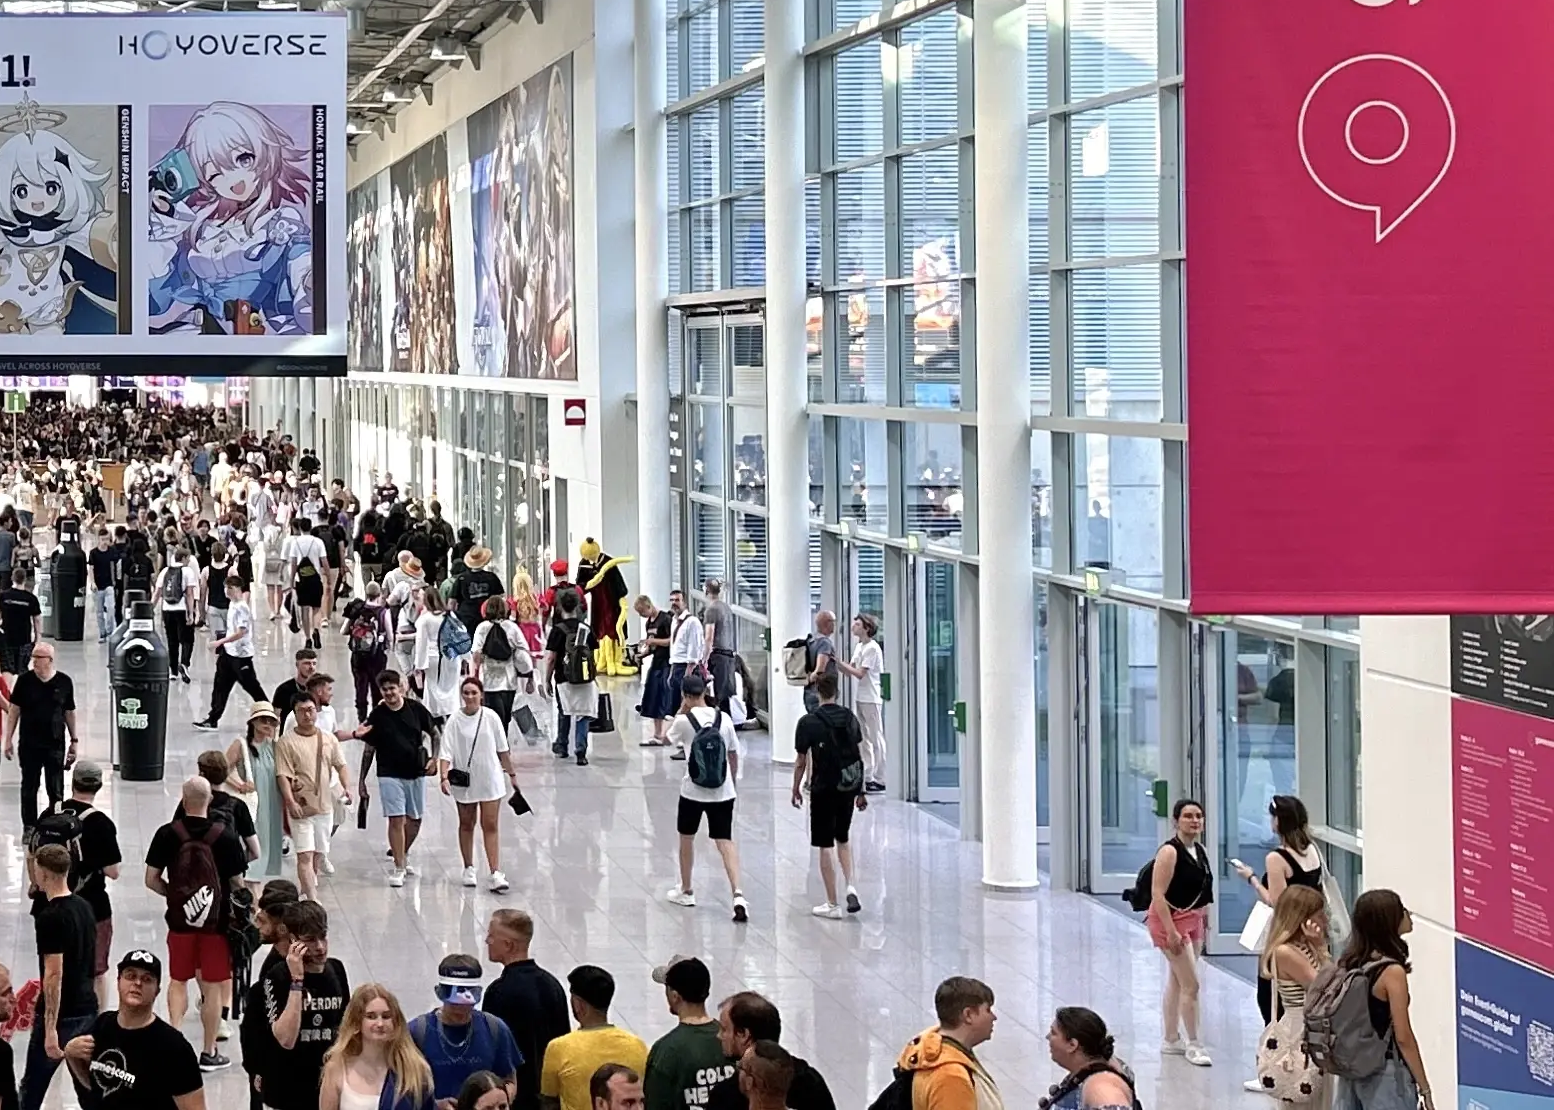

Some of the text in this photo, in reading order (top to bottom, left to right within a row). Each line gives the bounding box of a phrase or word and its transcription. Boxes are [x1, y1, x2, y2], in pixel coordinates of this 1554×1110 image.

[118, 29, 328, 61] HOYOVERSE
[121, 108, 130, 194] GENSHIN IMPACT
[315, 152, 325, 179] STAR
[315, 181, 324, 205] RAIL
[18, 362, 51, 371] ACROSS
[52, 362, 102, 371] HOYOVERSE
[183, 885, 209, 920] NIKE
[695, 1064, 735, 1086] COLD
